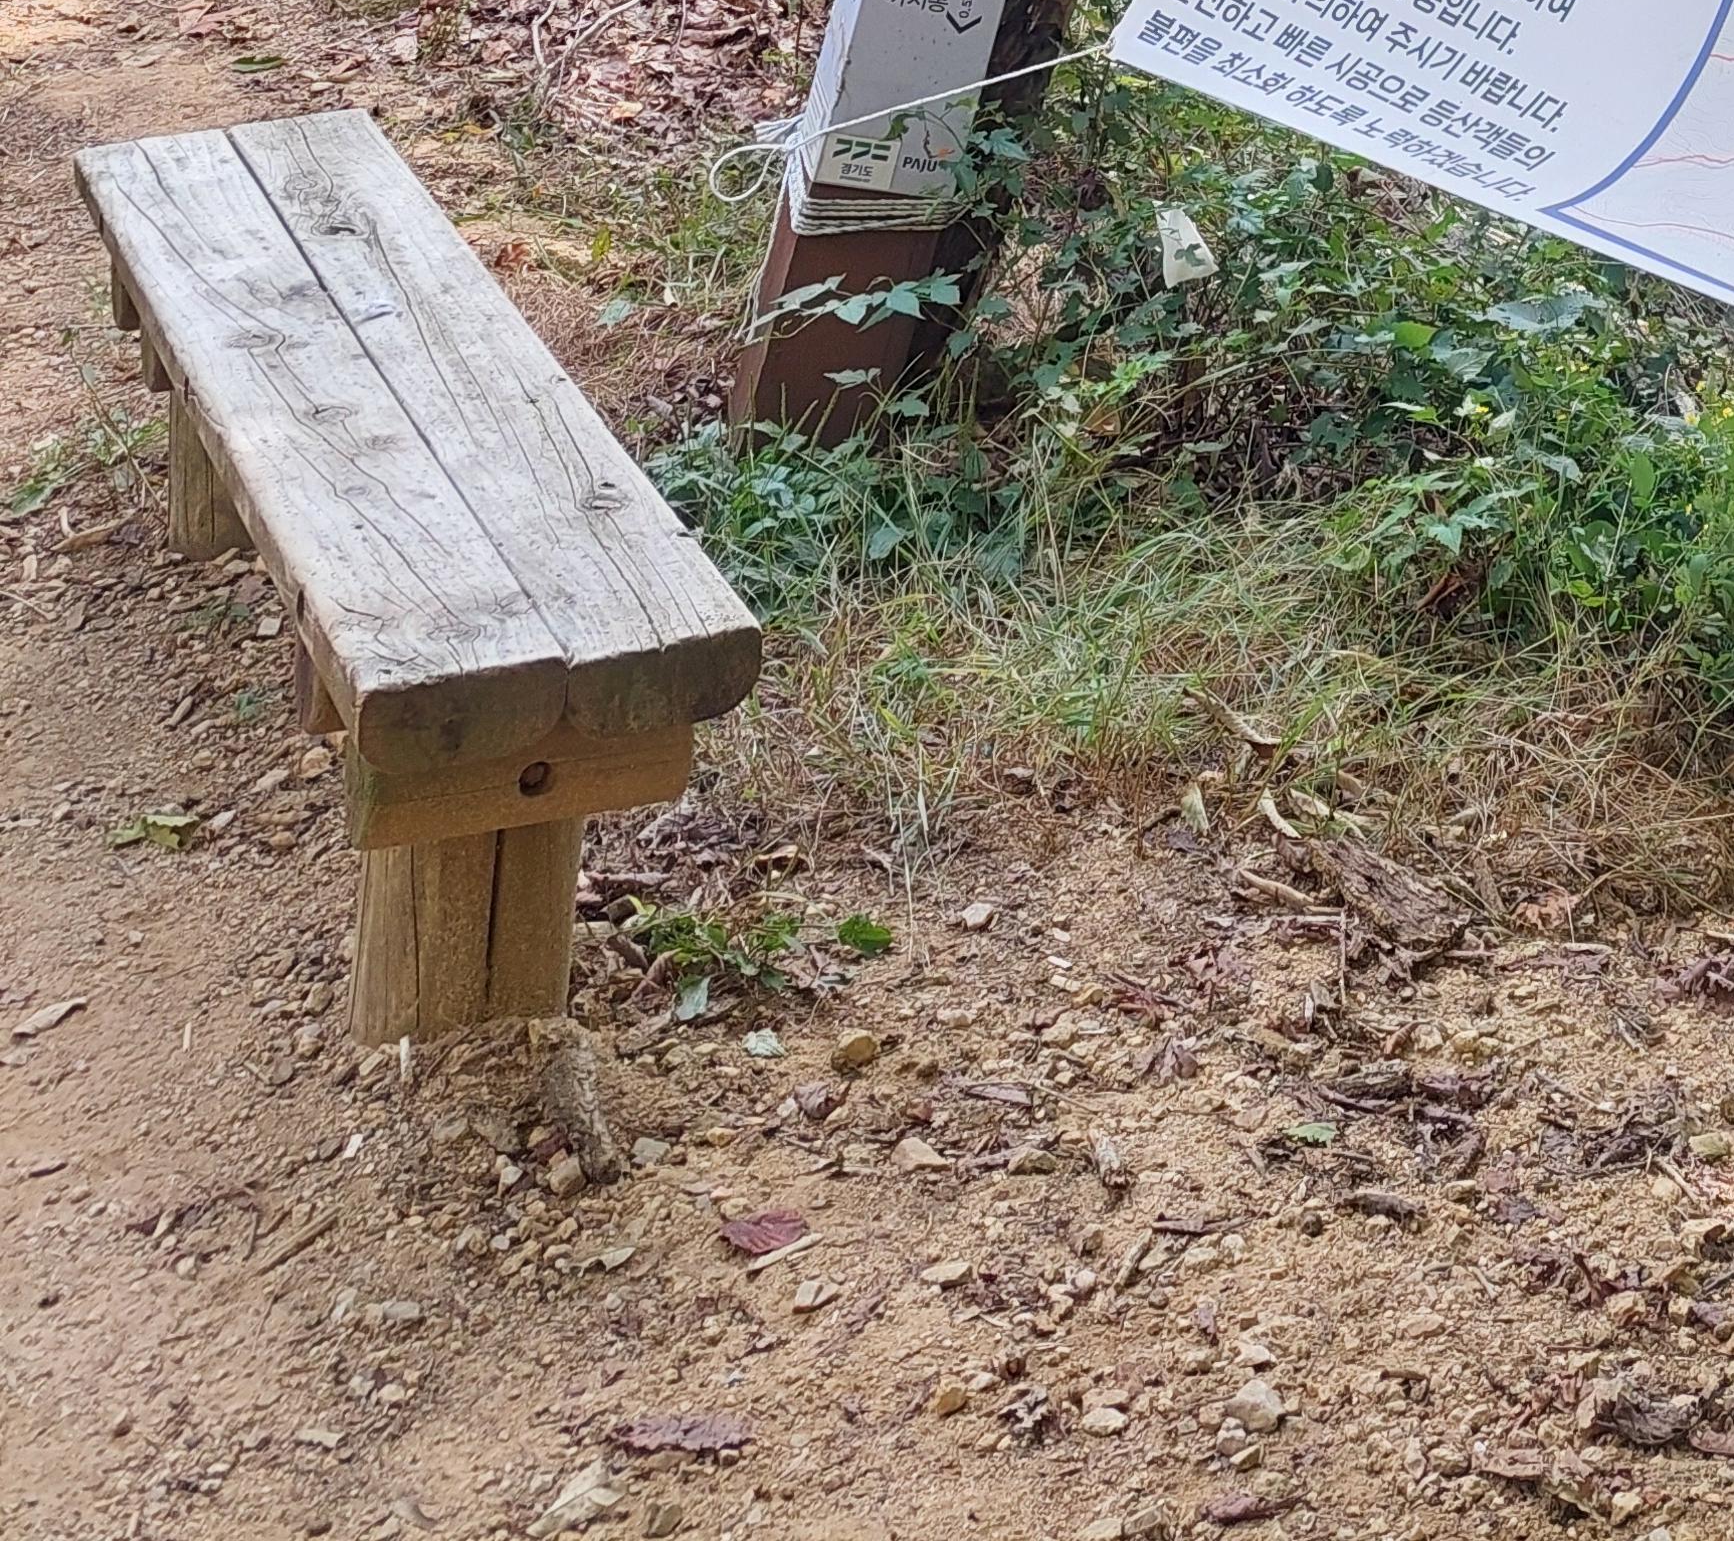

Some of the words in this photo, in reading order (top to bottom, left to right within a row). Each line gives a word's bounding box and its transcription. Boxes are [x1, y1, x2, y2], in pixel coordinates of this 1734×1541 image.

[1137, 9, 1223, 66] 불편을
[1212, 51, 1298, 96] 최소화
[1285, 84, 1369, 128] 하도록
[1273, 23, 1335, 69] 빠른
[1325, 51, 1431, 115] 시공으로
[1417, 100, 1556, 172] 등산객들의
[1385, 21, 1467, 78] 주시기
[1459, 52, 1570, 134] 바랍니다.
[841, 163, 873, 177] 경기도
[902, 156, 938, 172] PAJU
